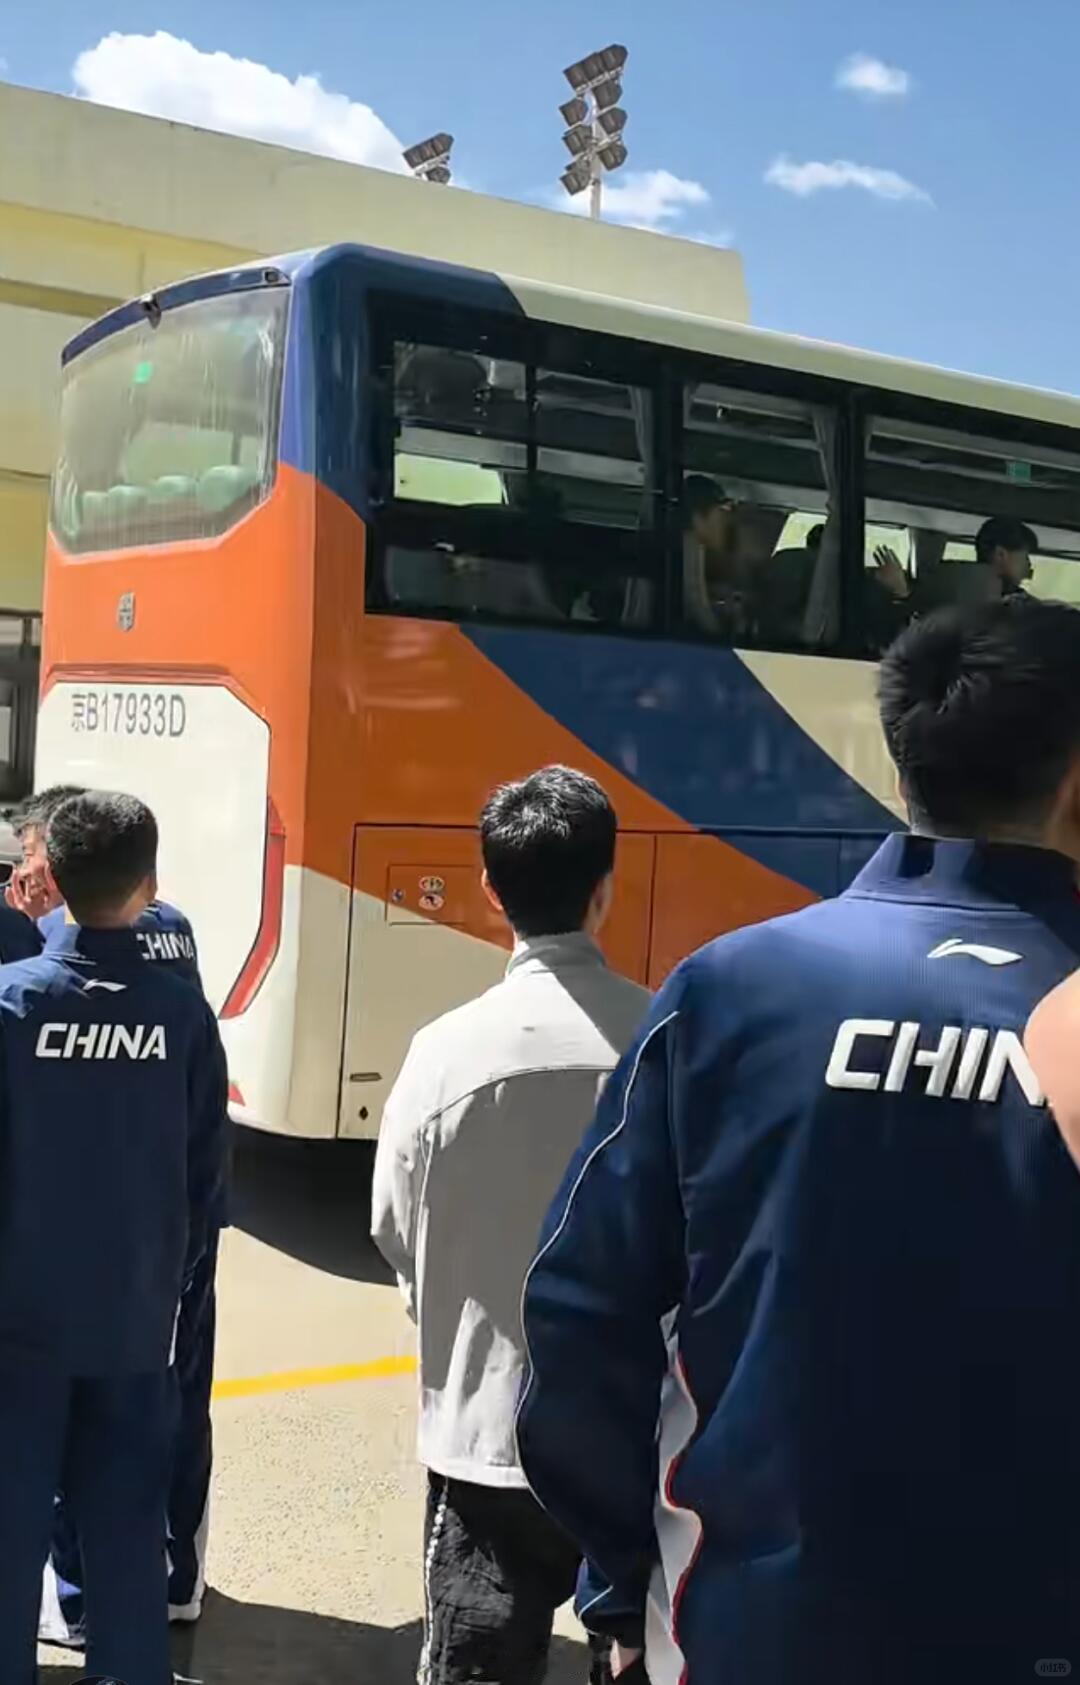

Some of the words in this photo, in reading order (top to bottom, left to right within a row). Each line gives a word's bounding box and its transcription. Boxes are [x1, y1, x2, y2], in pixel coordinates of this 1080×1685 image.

[71, 691, 186, 737] 京B17933D
[35, 1022, 167, 1060] CHINA
[825, 1018, 1051, 1107] CHIN
